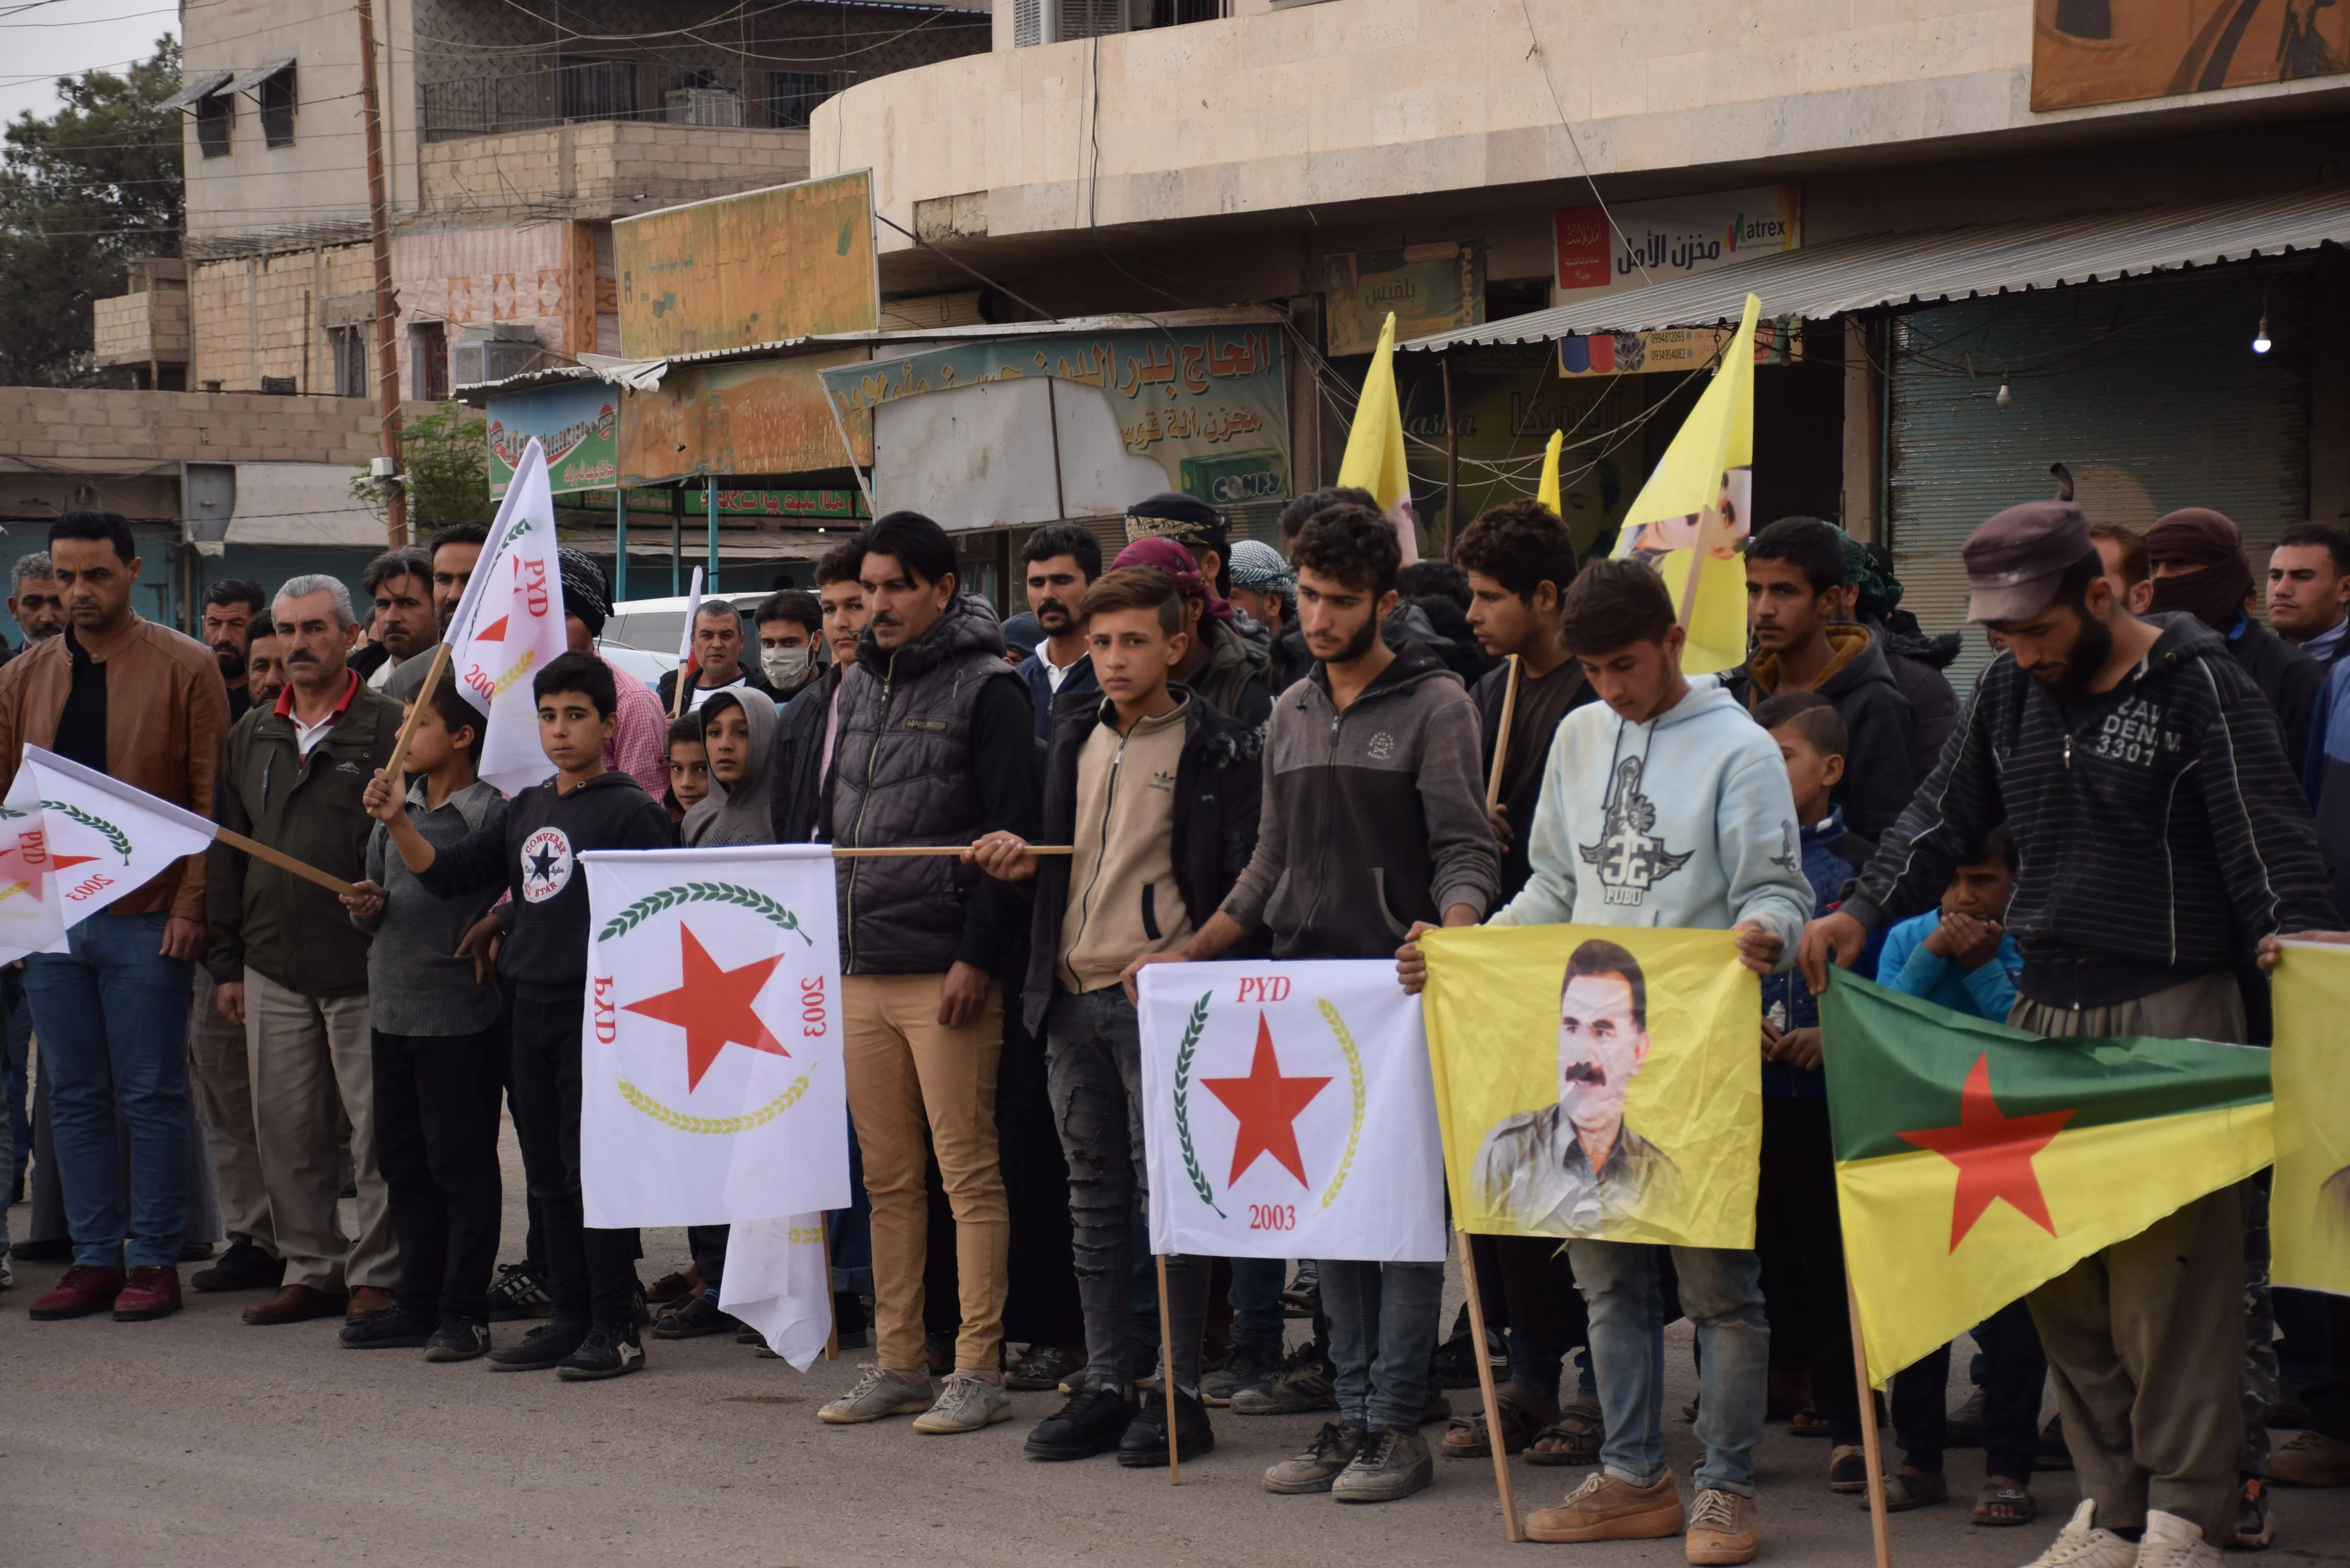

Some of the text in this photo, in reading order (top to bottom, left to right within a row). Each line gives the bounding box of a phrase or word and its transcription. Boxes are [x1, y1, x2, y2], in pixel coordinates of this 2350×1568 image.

[1617, 230, 1720, 274] مخزن الأمل
[1365, 278, 1415, 309] بلقيس
[1651, 331, 1685, 344] 0994812093
[1120, 340, 1177, 400] بدر
[1180, 327, 1272, 395] الحاج
[1651, 348, 1686, 361] 0934954082
[1395, 378, 1478, 437] lasa
[1204, 406, 1262, 444] مخزن
[1213, 470, 1282, 502] COMFY
[524, 557, 548, 618] PYD
[464, 664, 495, 705] 200
[2103, 714, 2182, 753] DENM
[19, 830, 47, 864] PYD
[525, 832, 567, 855] CONVERSE
[535, 881, 558, 897] STAR
[1605, 885, 1644, 905] FUBU
[1236, 976, 1292, 1003] PYD
[1248, 1204, 1296, 1231] 2003
[511, 1284, 537, 1302] FASHION
